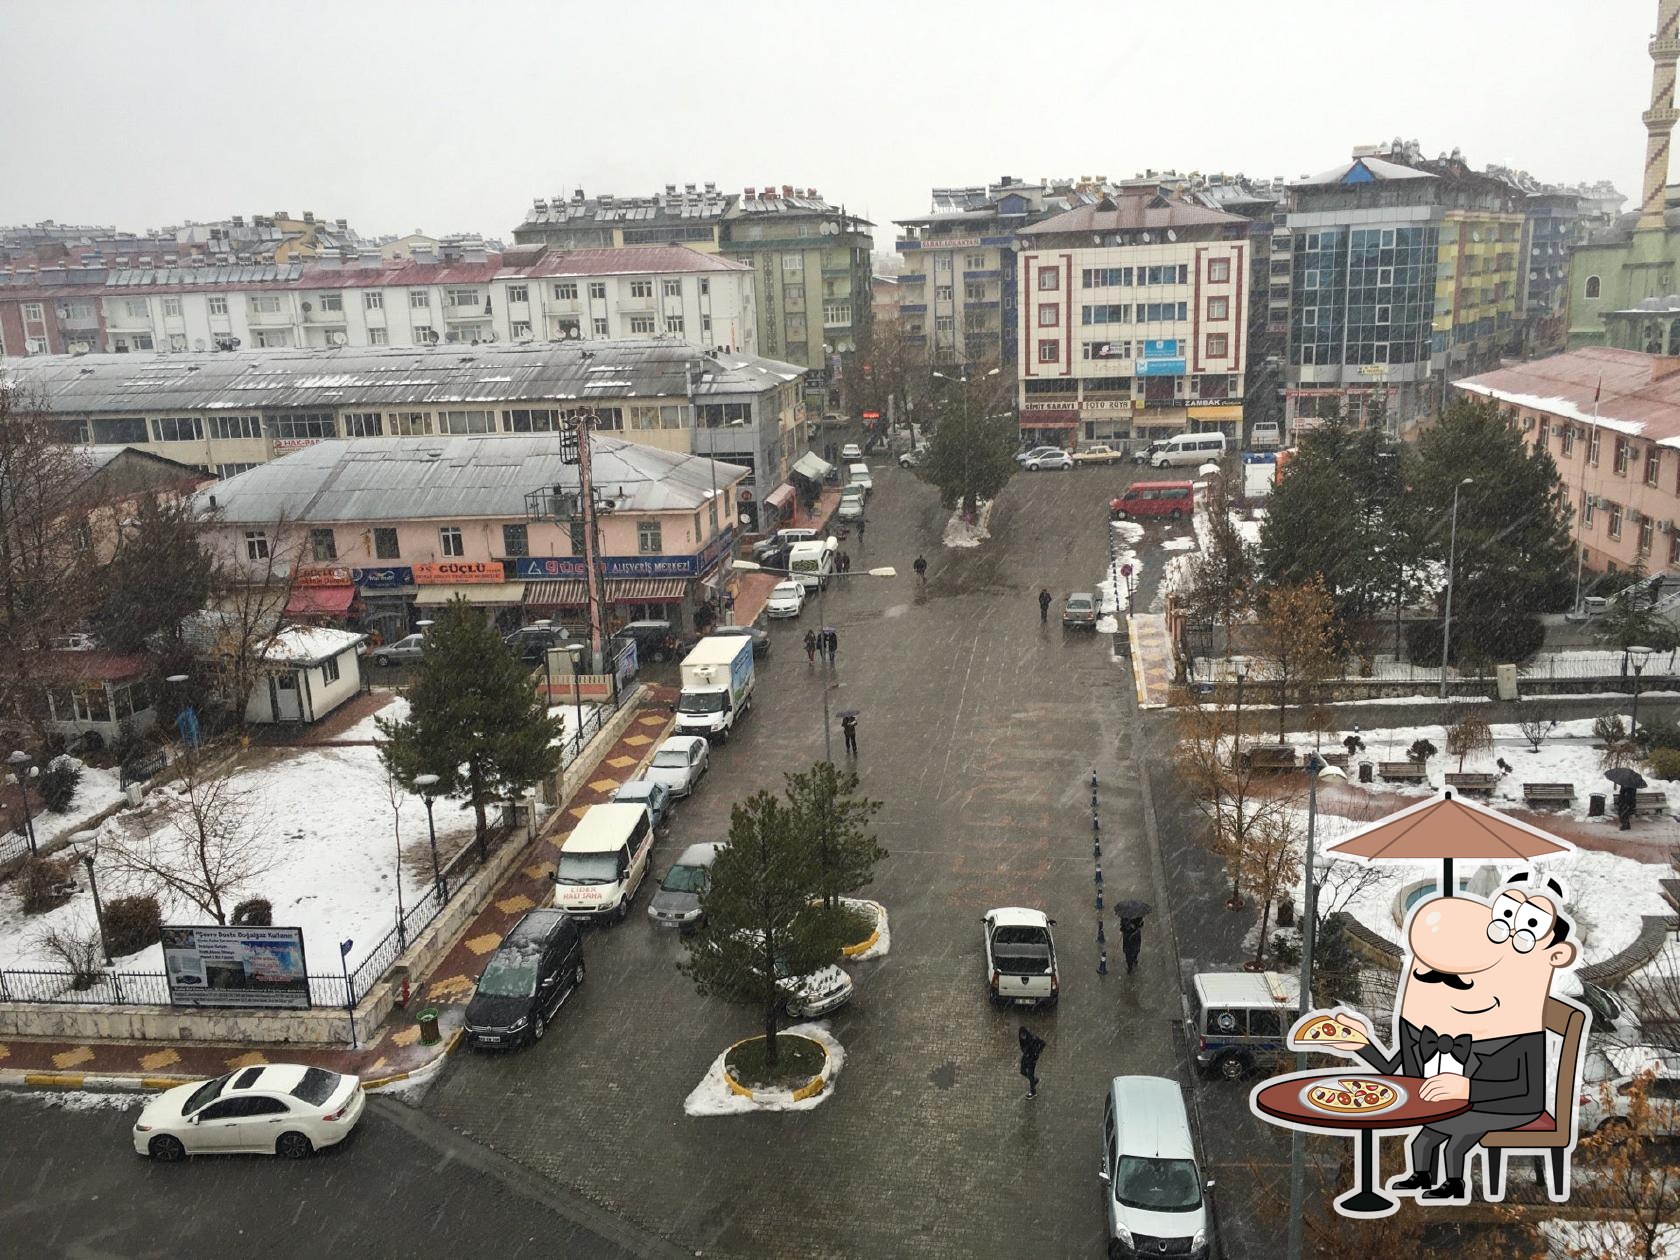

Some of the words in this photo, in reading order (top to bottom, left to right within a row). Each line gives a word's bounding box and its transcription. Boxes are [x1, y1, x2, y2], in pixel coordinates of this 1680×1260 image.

[1184, 399, 1220, 407] ZAMBAK
[439, 562, 486, 574] GÜÇLÜ
[612, 561, 652, 574] ALIŞVERİŞ
